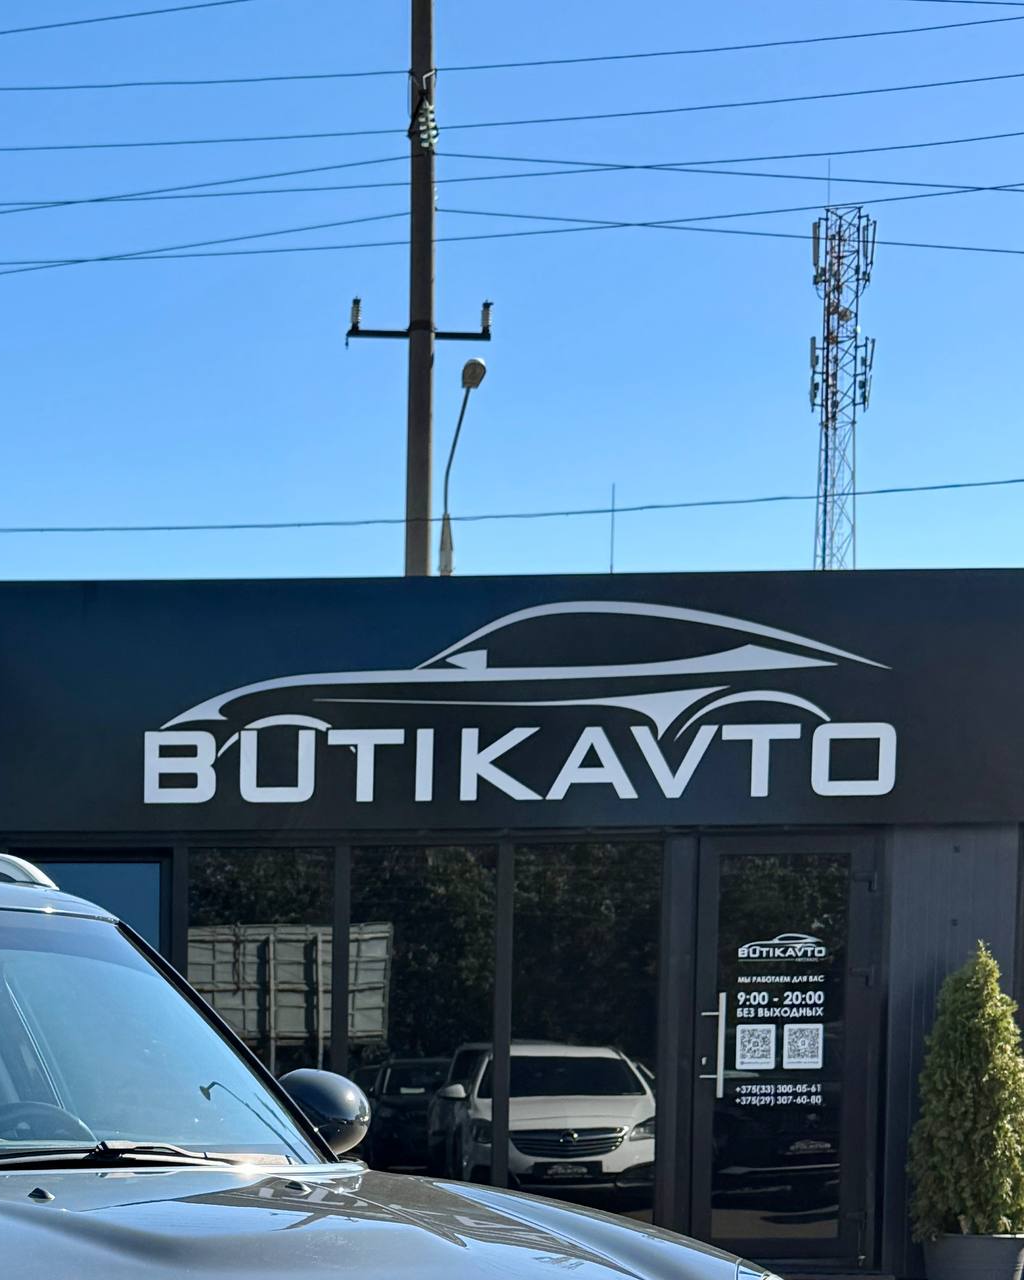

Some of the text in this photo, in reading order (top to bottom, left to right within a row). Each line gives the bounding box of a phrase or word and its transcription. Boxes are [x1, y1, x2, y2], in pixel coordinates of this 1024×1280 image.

[142, 721, 898, 804] BUTIKAVTO
[738, 946, 826, 958] BUTIKAVTO
[752, 975, 791, 983] РАБОТАЕМ
[737, 991, 769, 1006] 9:00
[783, 990, 825, 1005] 20:00
[736, 1006, 824, 1018] БЕЗ ВЫХОДНЫХ
[736, 1083, 822, 1095] +375(33) 300-05-61
[736, 1096, 775, 1106] +375(29)
